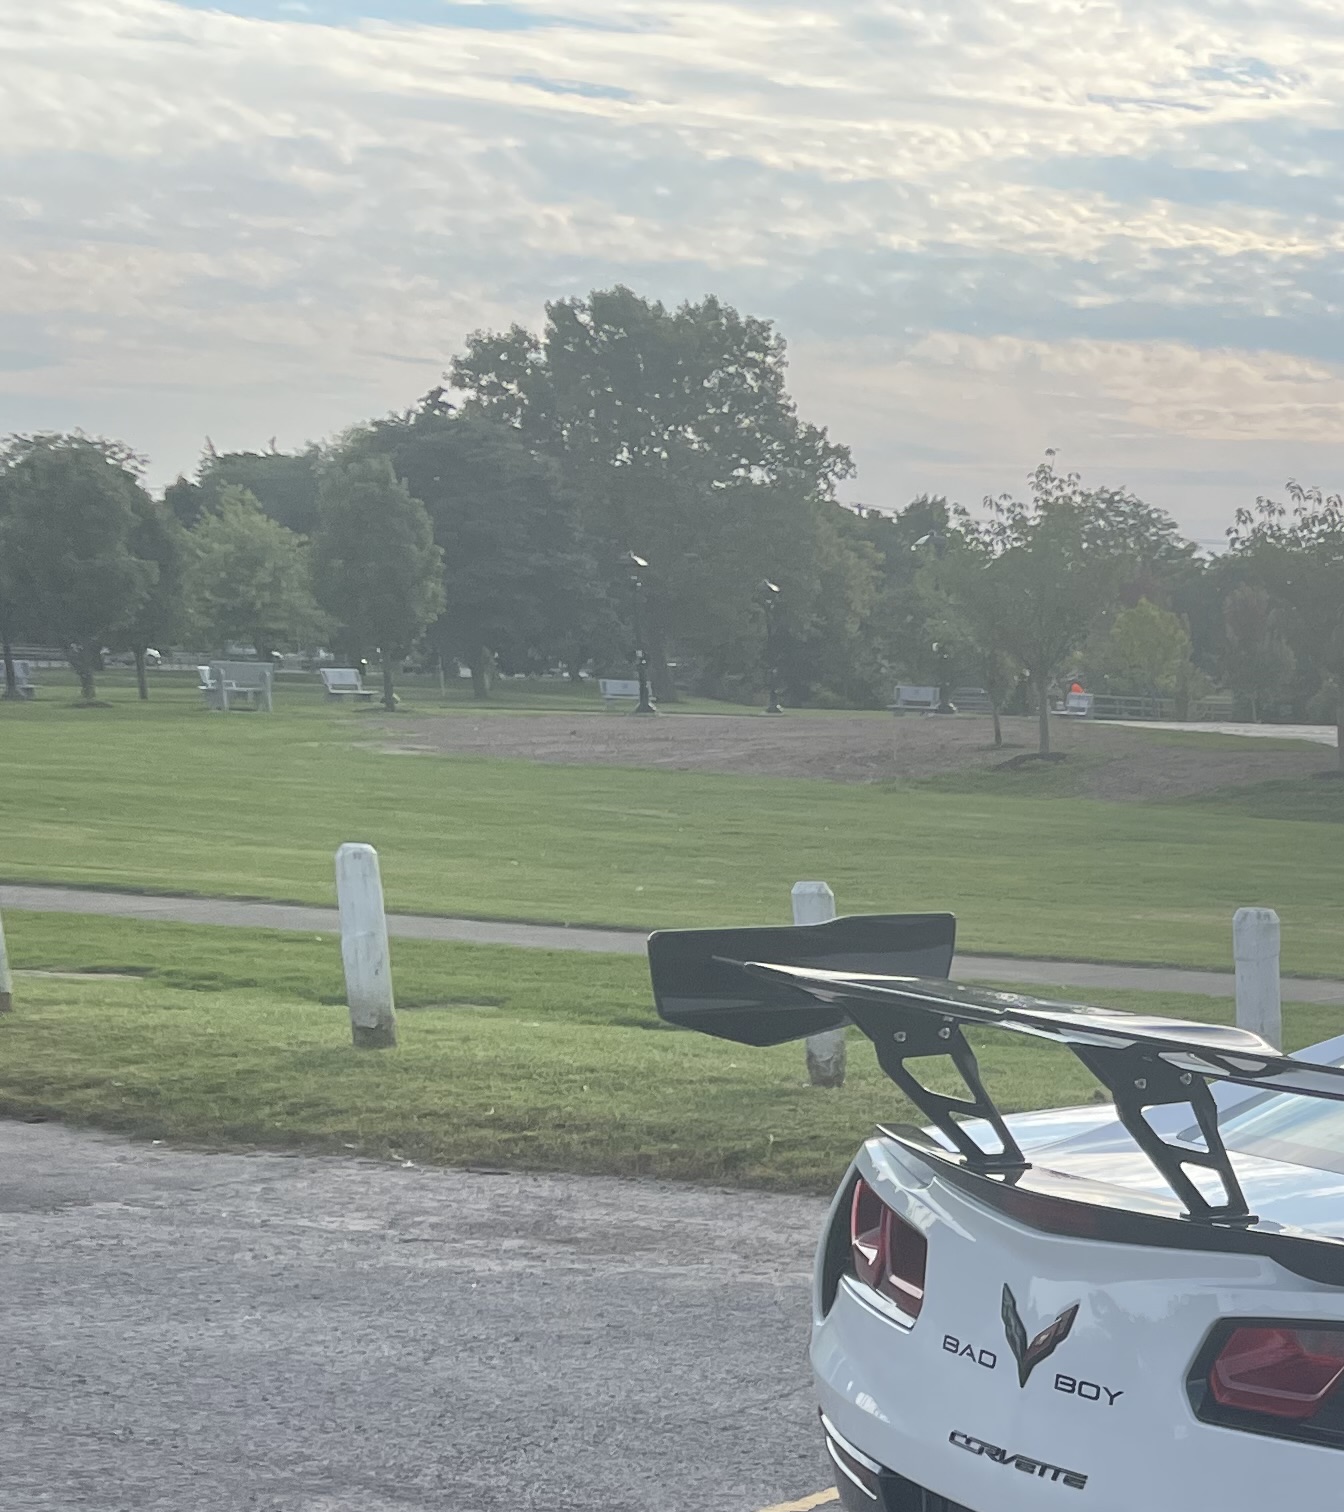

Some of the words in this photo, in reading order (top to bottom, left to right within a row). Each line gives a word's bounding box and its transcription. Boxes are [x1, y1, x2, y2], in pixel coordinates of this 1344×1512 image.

[942, 1334, 997, 1369] BAD
[1054, 1373, 1124, 1405] BOY
[948, 1429, 1088, 1490] CORVETTE
